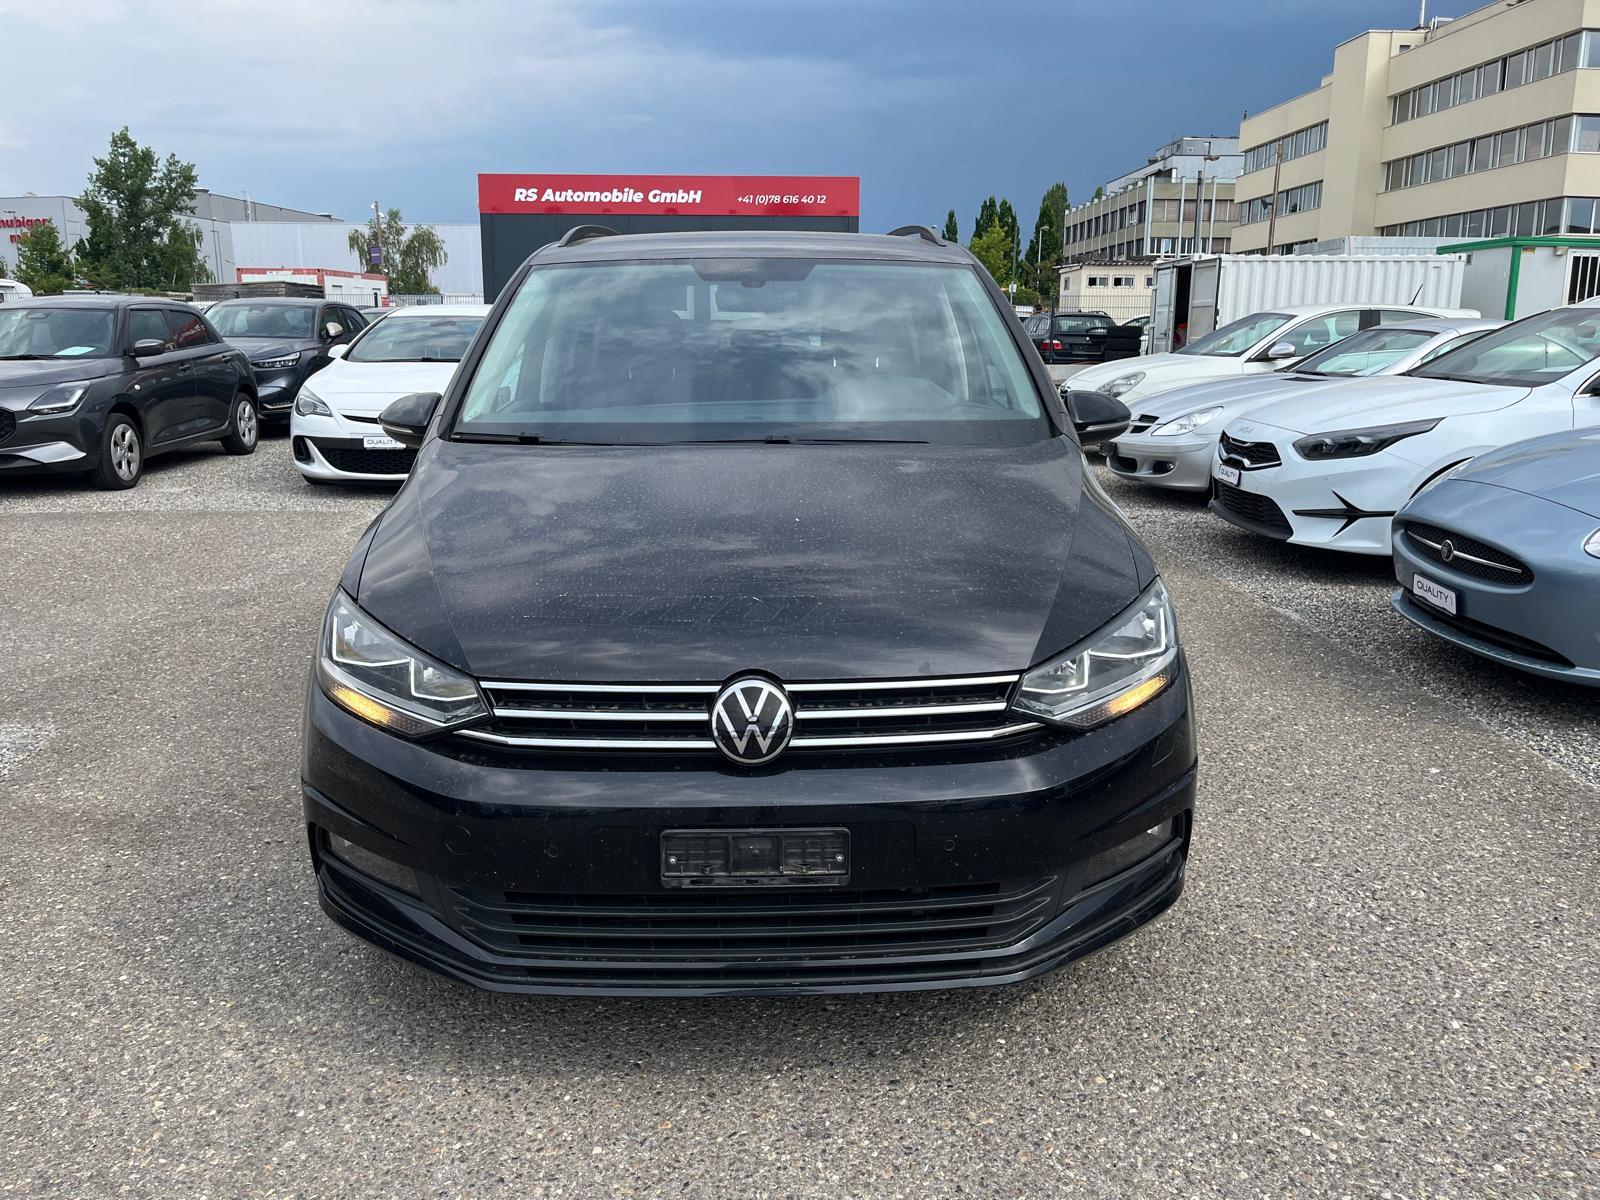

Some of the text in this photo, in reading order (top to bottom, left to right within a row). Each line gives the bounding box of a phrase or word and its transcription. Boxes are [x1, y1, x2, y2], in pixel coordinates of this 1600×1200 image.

[514, 188, 702, 203] RS Automobile GmbH
[737, 194, 827, 206] +41 (0)78 616 40 12
[712, 679, 794, 764] VW
